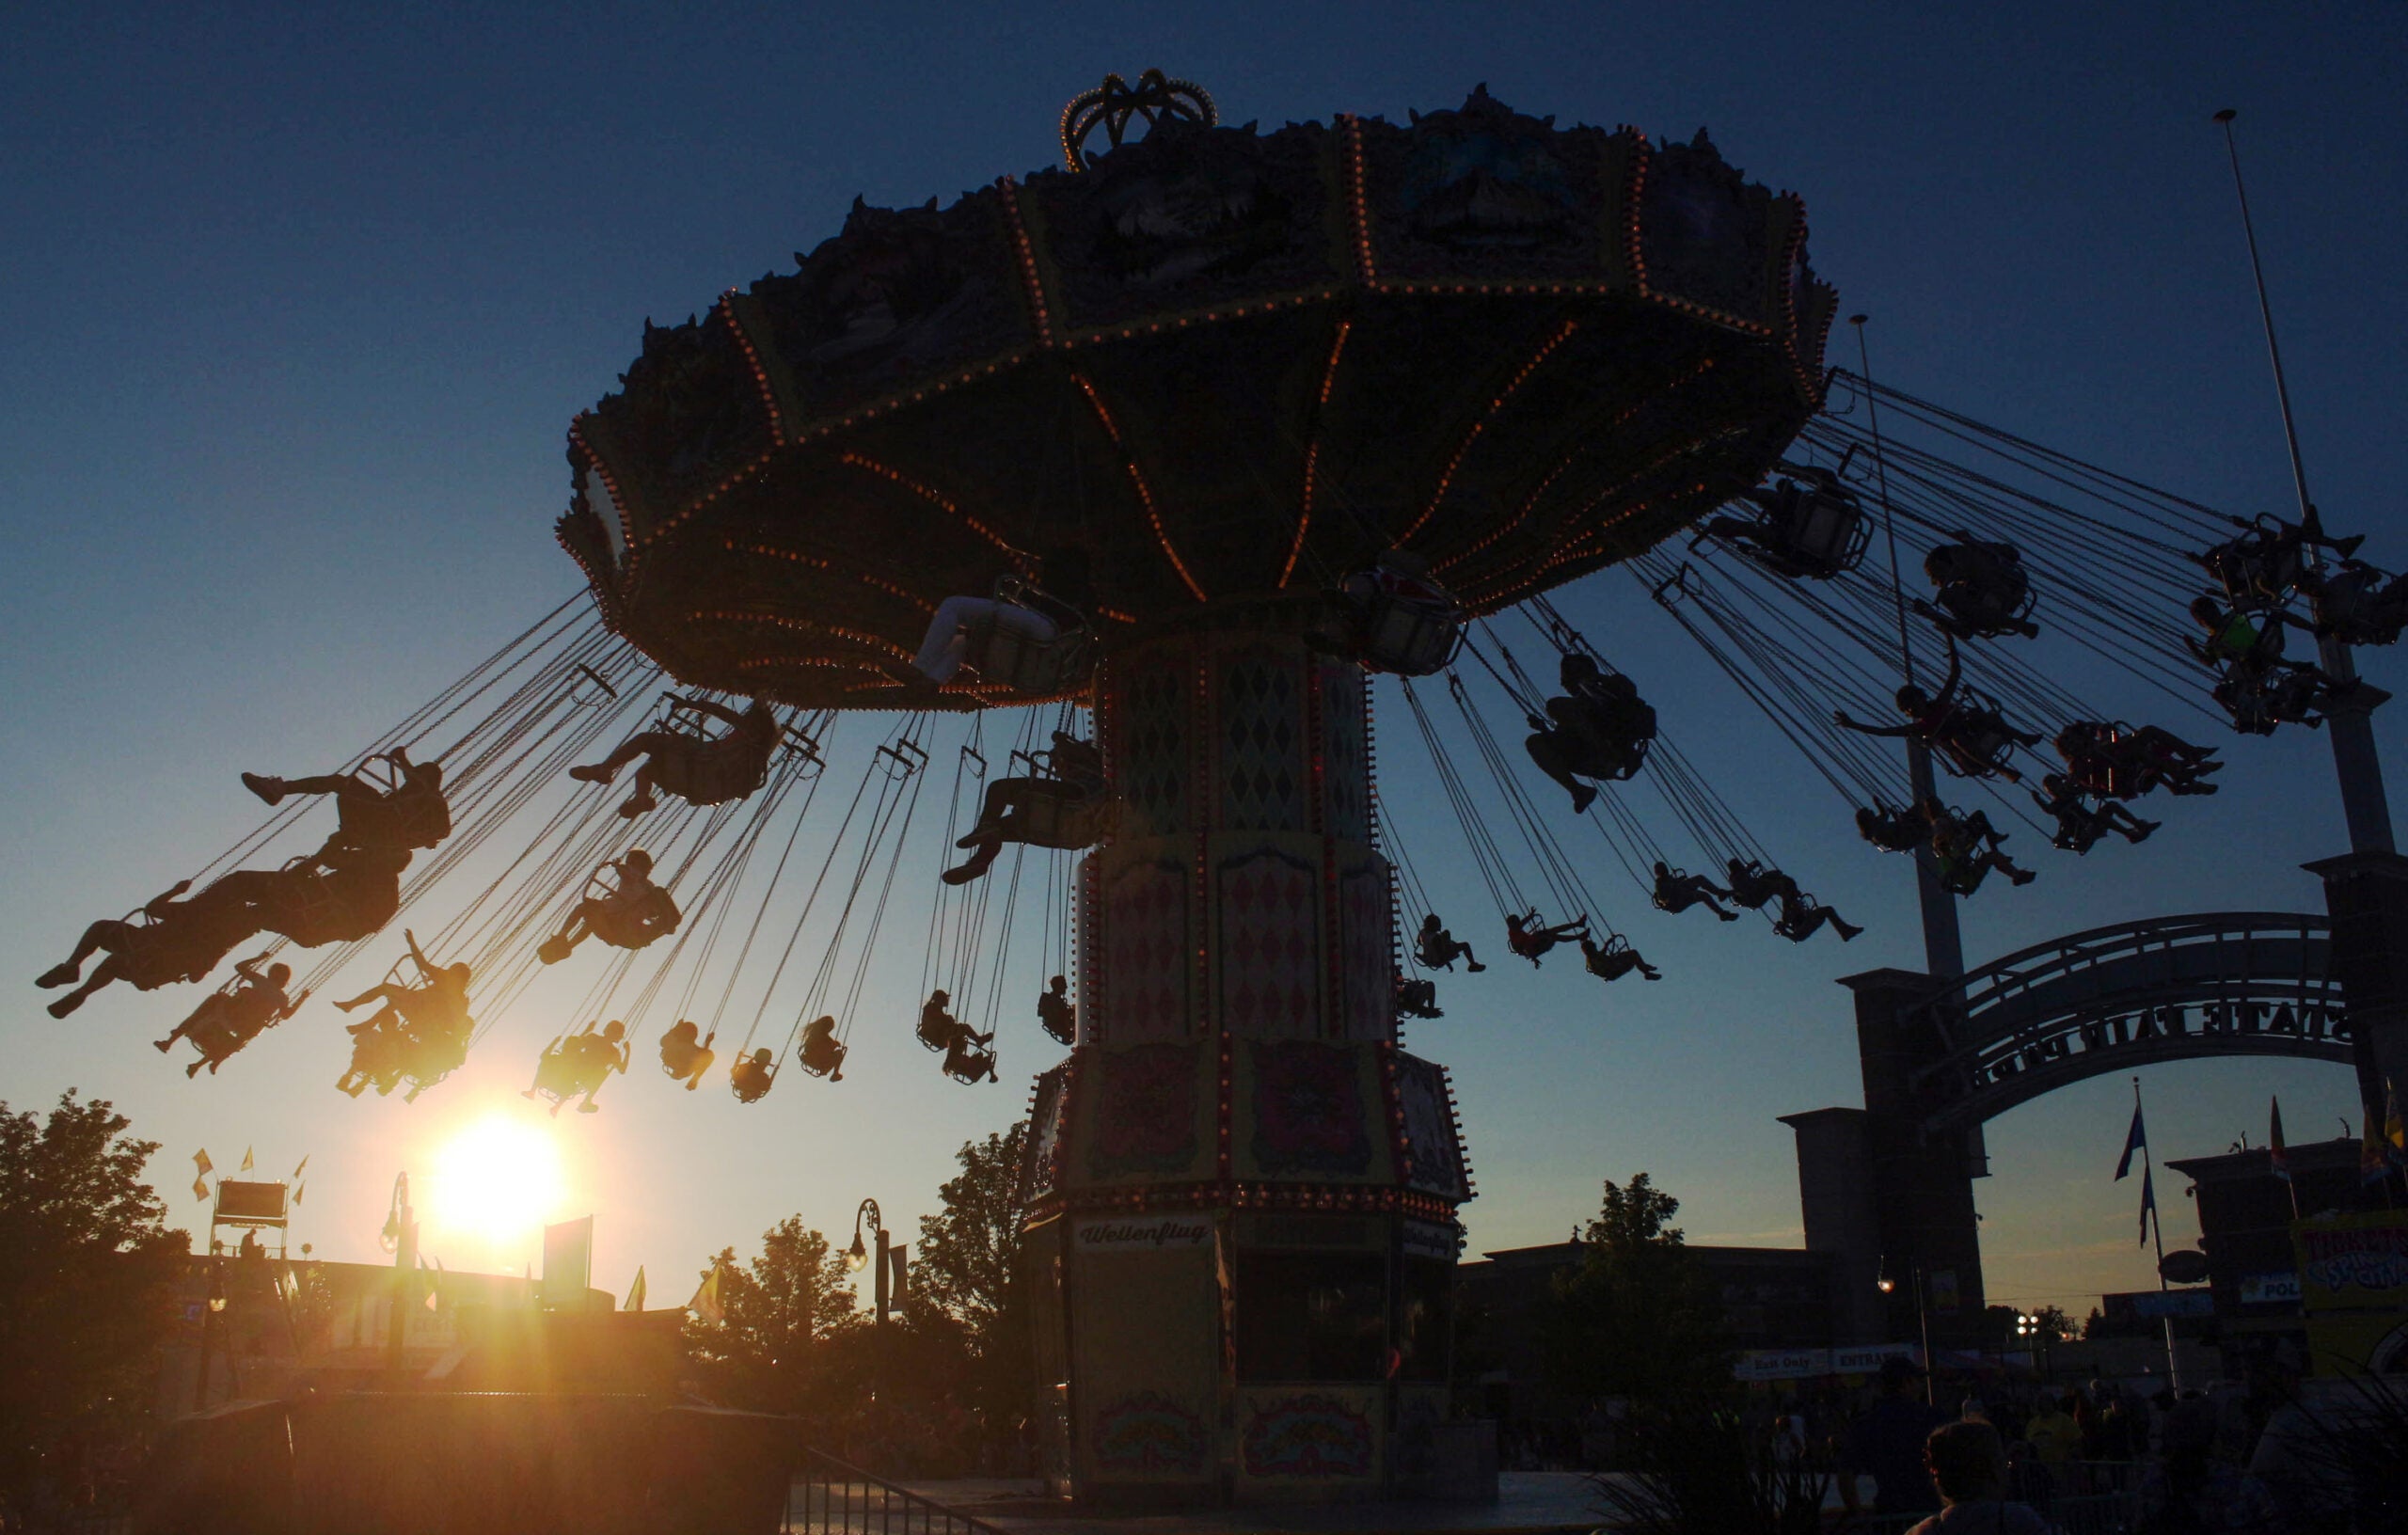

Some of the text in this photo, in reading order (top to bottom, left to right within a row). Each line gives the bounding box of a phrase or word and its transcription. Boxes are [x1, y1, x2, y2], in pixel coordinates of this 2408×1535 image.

[1080, 1222, 1209, 1245] Wellenflug
[2264, 1282, 2302, 1299] POL
[1782, 1356, 1811, 1369] Only
